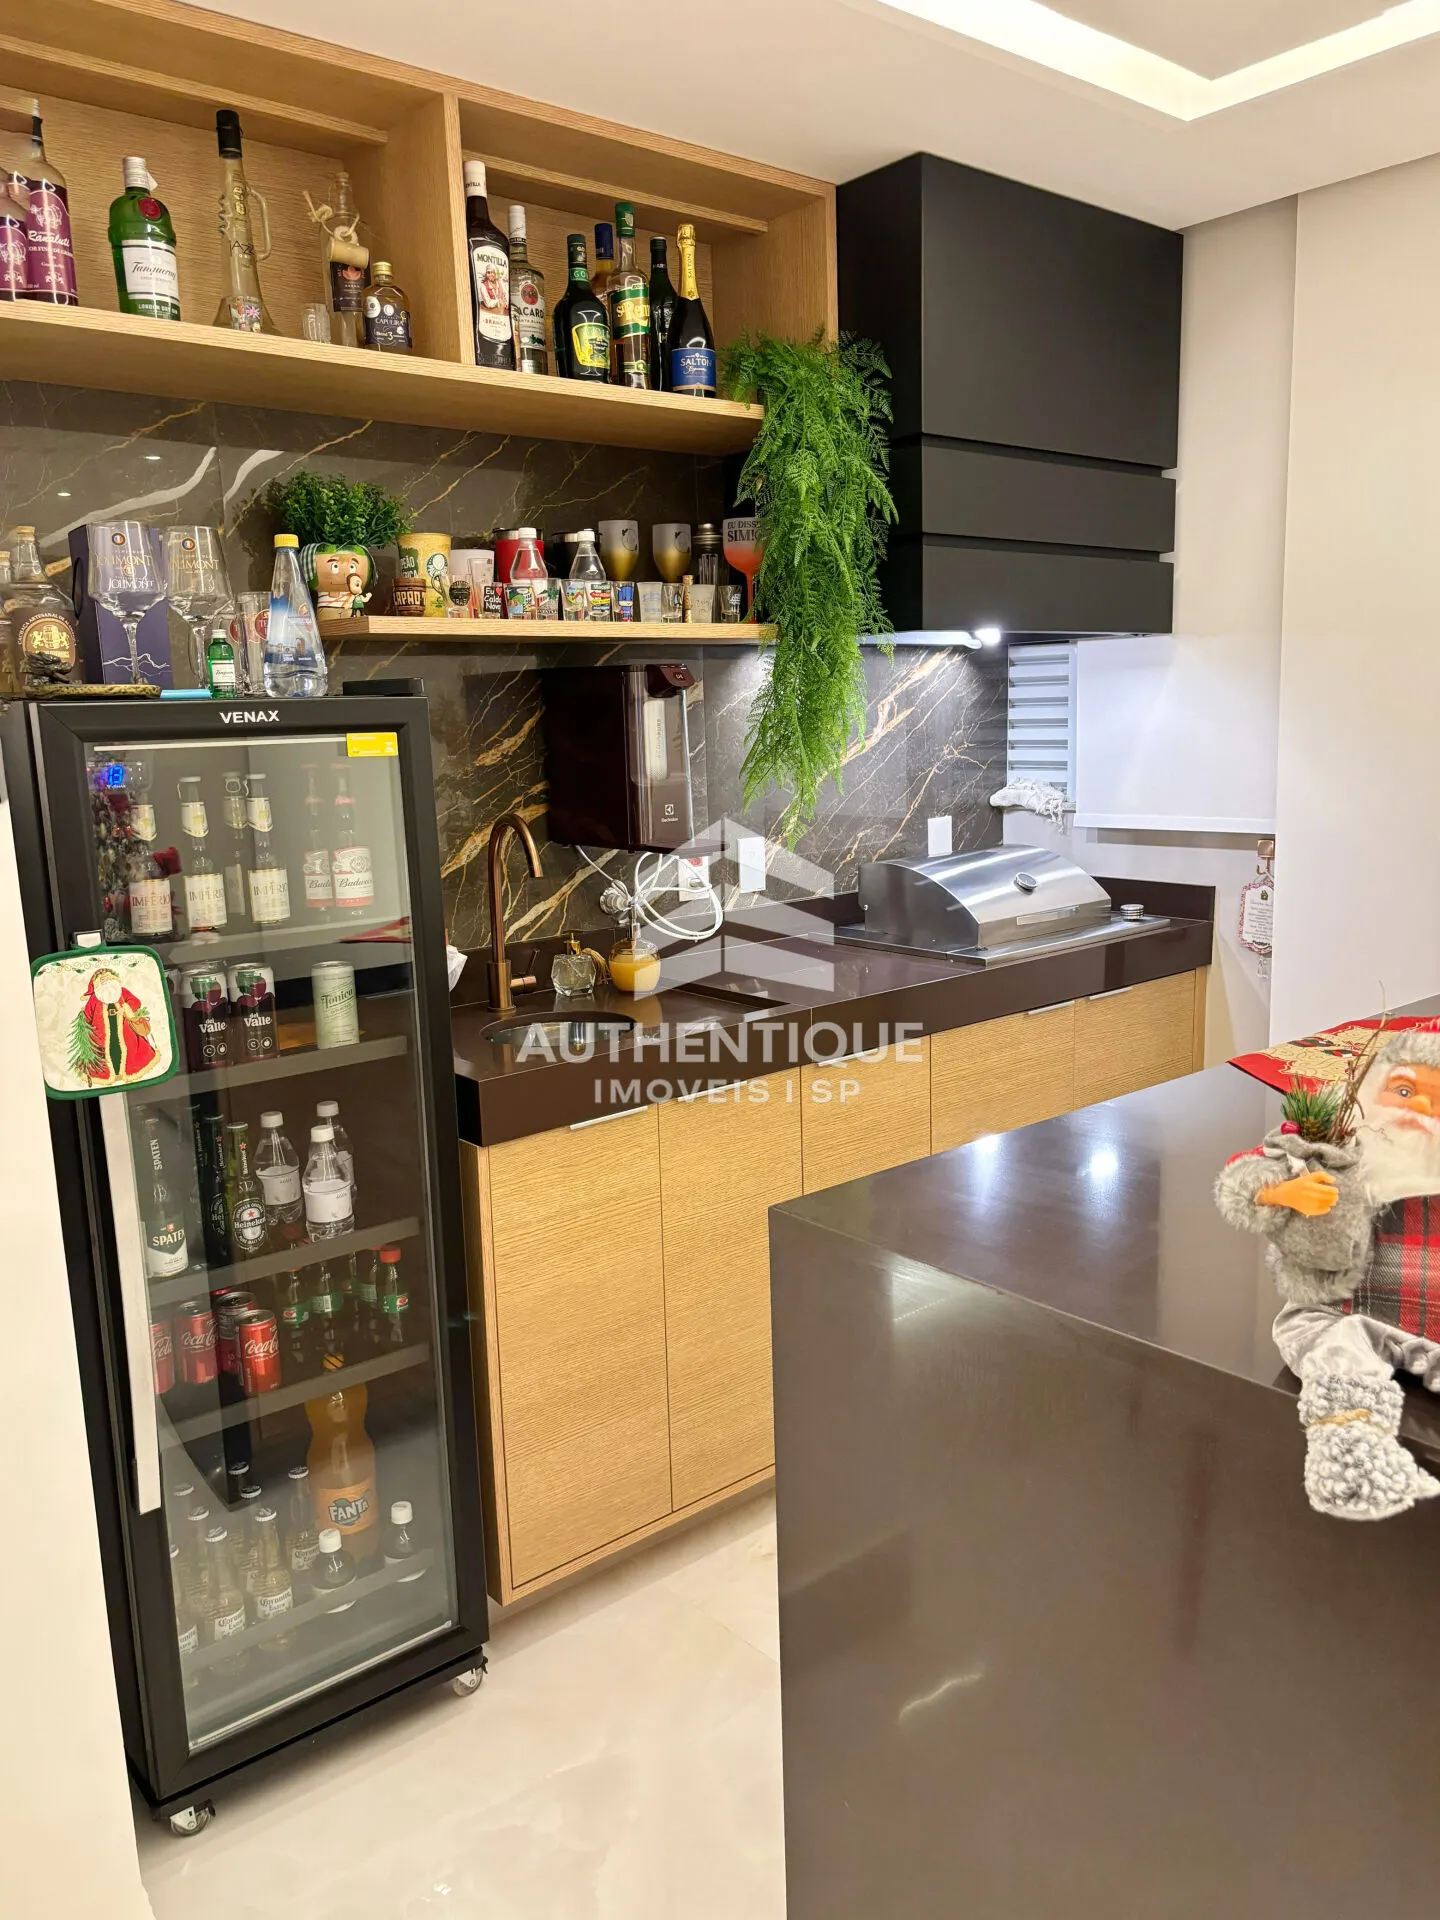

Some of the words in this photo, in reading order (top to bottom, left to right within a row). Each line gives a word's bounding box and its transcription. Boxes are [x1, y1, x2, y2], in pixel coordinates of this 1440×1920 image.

[476, 253, 508, 268] MONTILLA
[516, 306, 546, 319] ACARD
[680, 357, 712, 368] SALTON
[727, 521, 736, 530] EU
[738, 520, 758, 529] DISS
[727, 529, 755, 543] SIM!
[485, 587, 495, 595] Eu
[219, 710, 280, 724] VENAX
[198, 1021, 228, 1034] Valle
[243, 1016, 273, 1027] Valle
[149, 1138, 163, 1171] SPATEN
[234, 1216, 267, 1229] Heineken
[329, 1499, 369, 1521] FANTA
